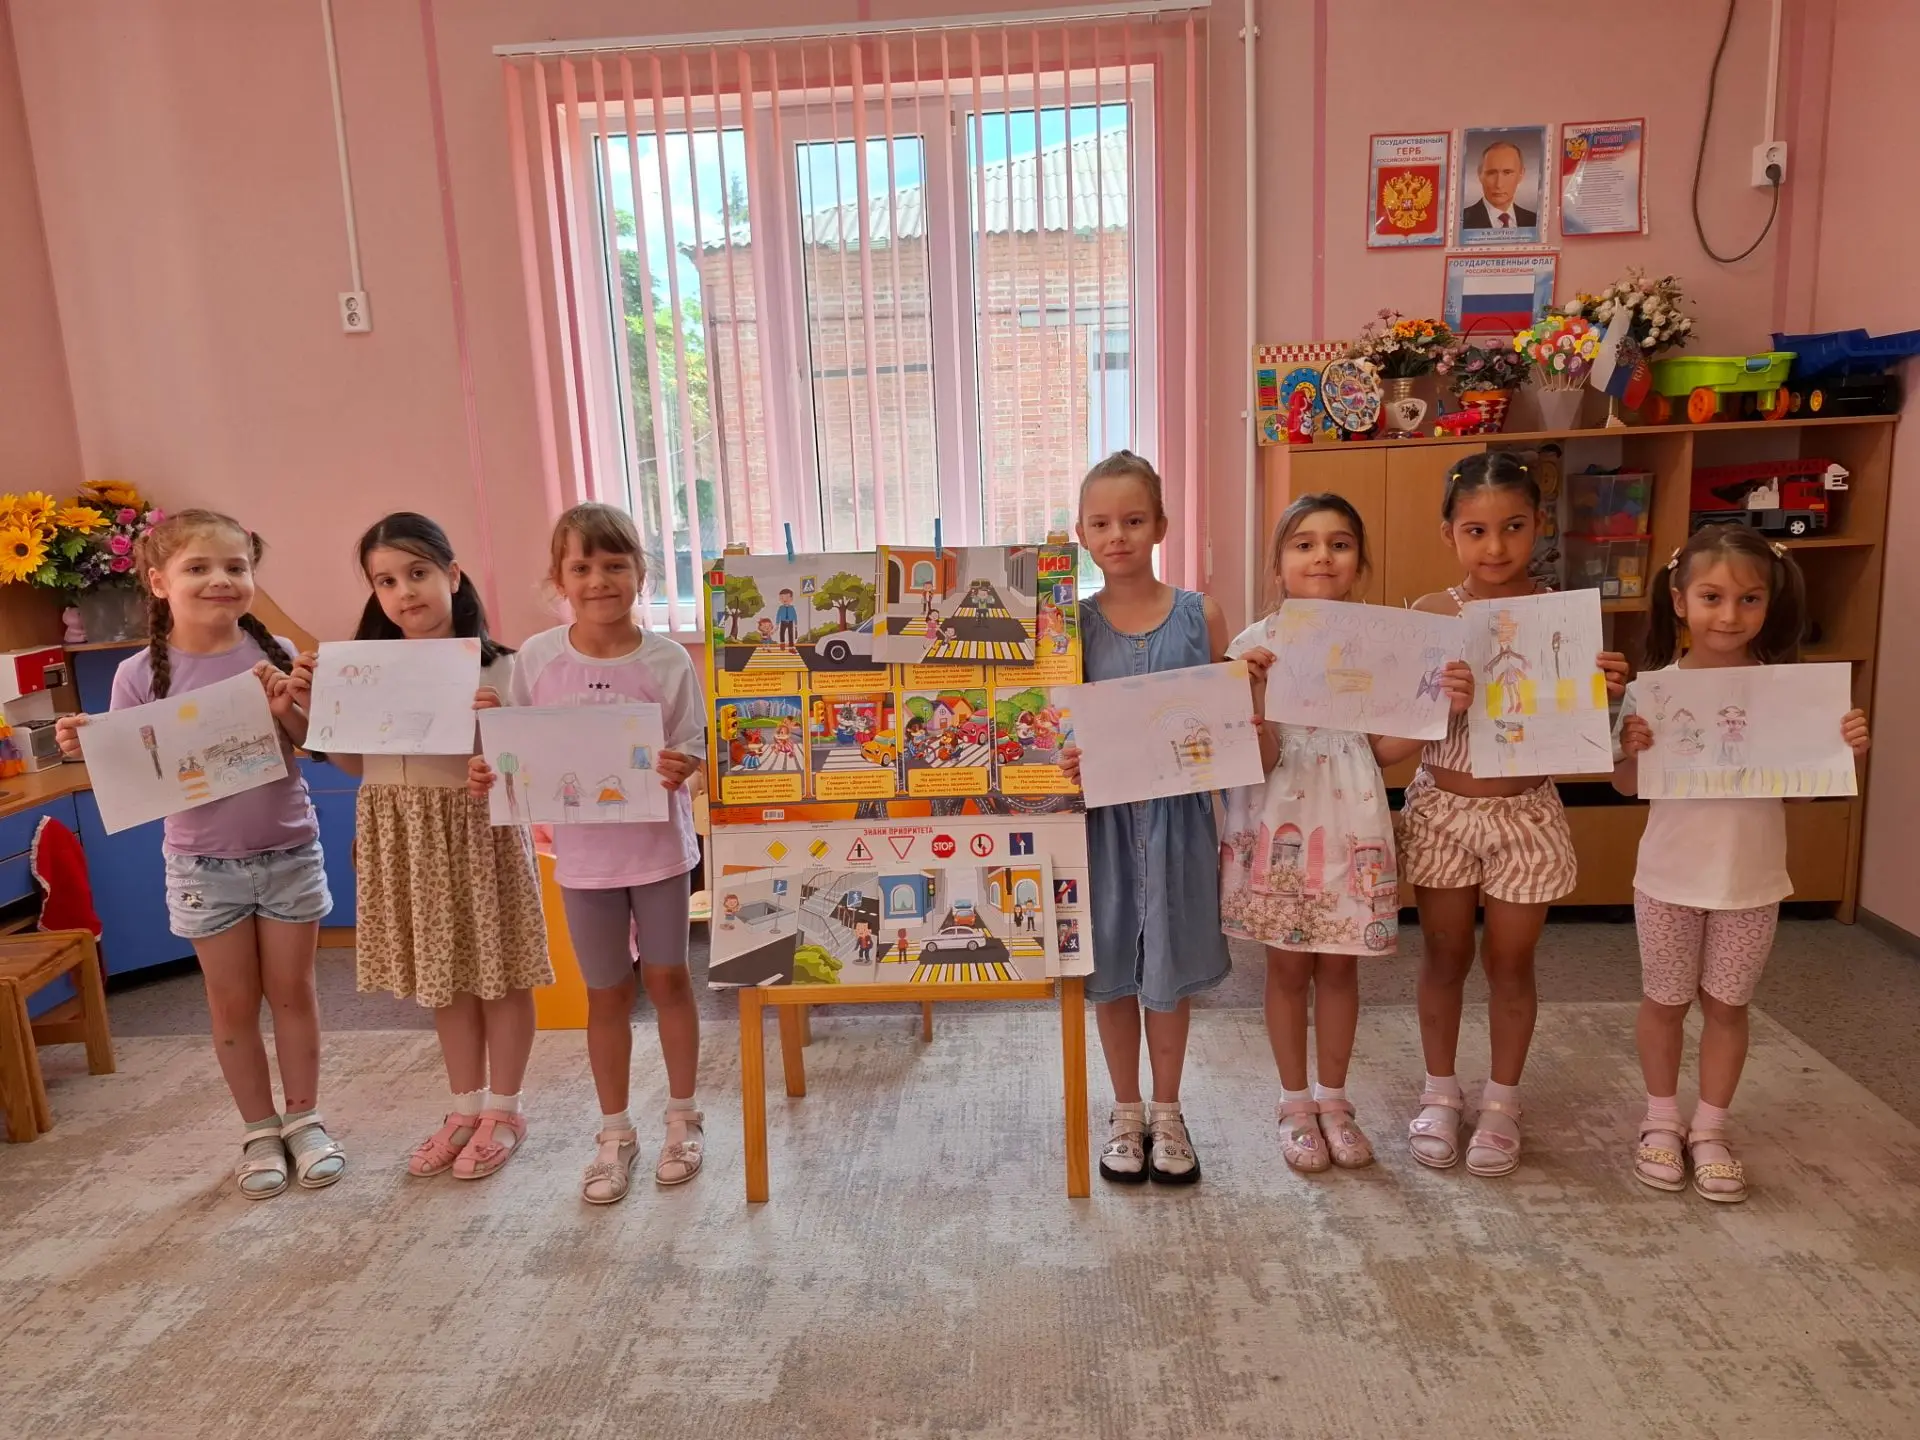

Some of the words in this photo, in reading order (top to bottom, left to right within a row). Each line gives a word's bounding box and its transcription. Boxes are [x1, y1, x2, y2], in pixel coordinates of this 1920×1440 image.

[1376, 137, 1443, 146] ГОСУДАРСТВЕННЫЙ
[1396, 146, 1422, 155] ГЕРБ
[1448, 258, 1531, 268] ГОСУДАРСТВЕННЫЙ
[1531, 257, 1554, 265] ФЛАГ
[863, 828, 887, 836] ЗНАКИ
[888, 826, 934, 836] ПРИОРИТЕТА
[932, 841, 954, 851] STOP
